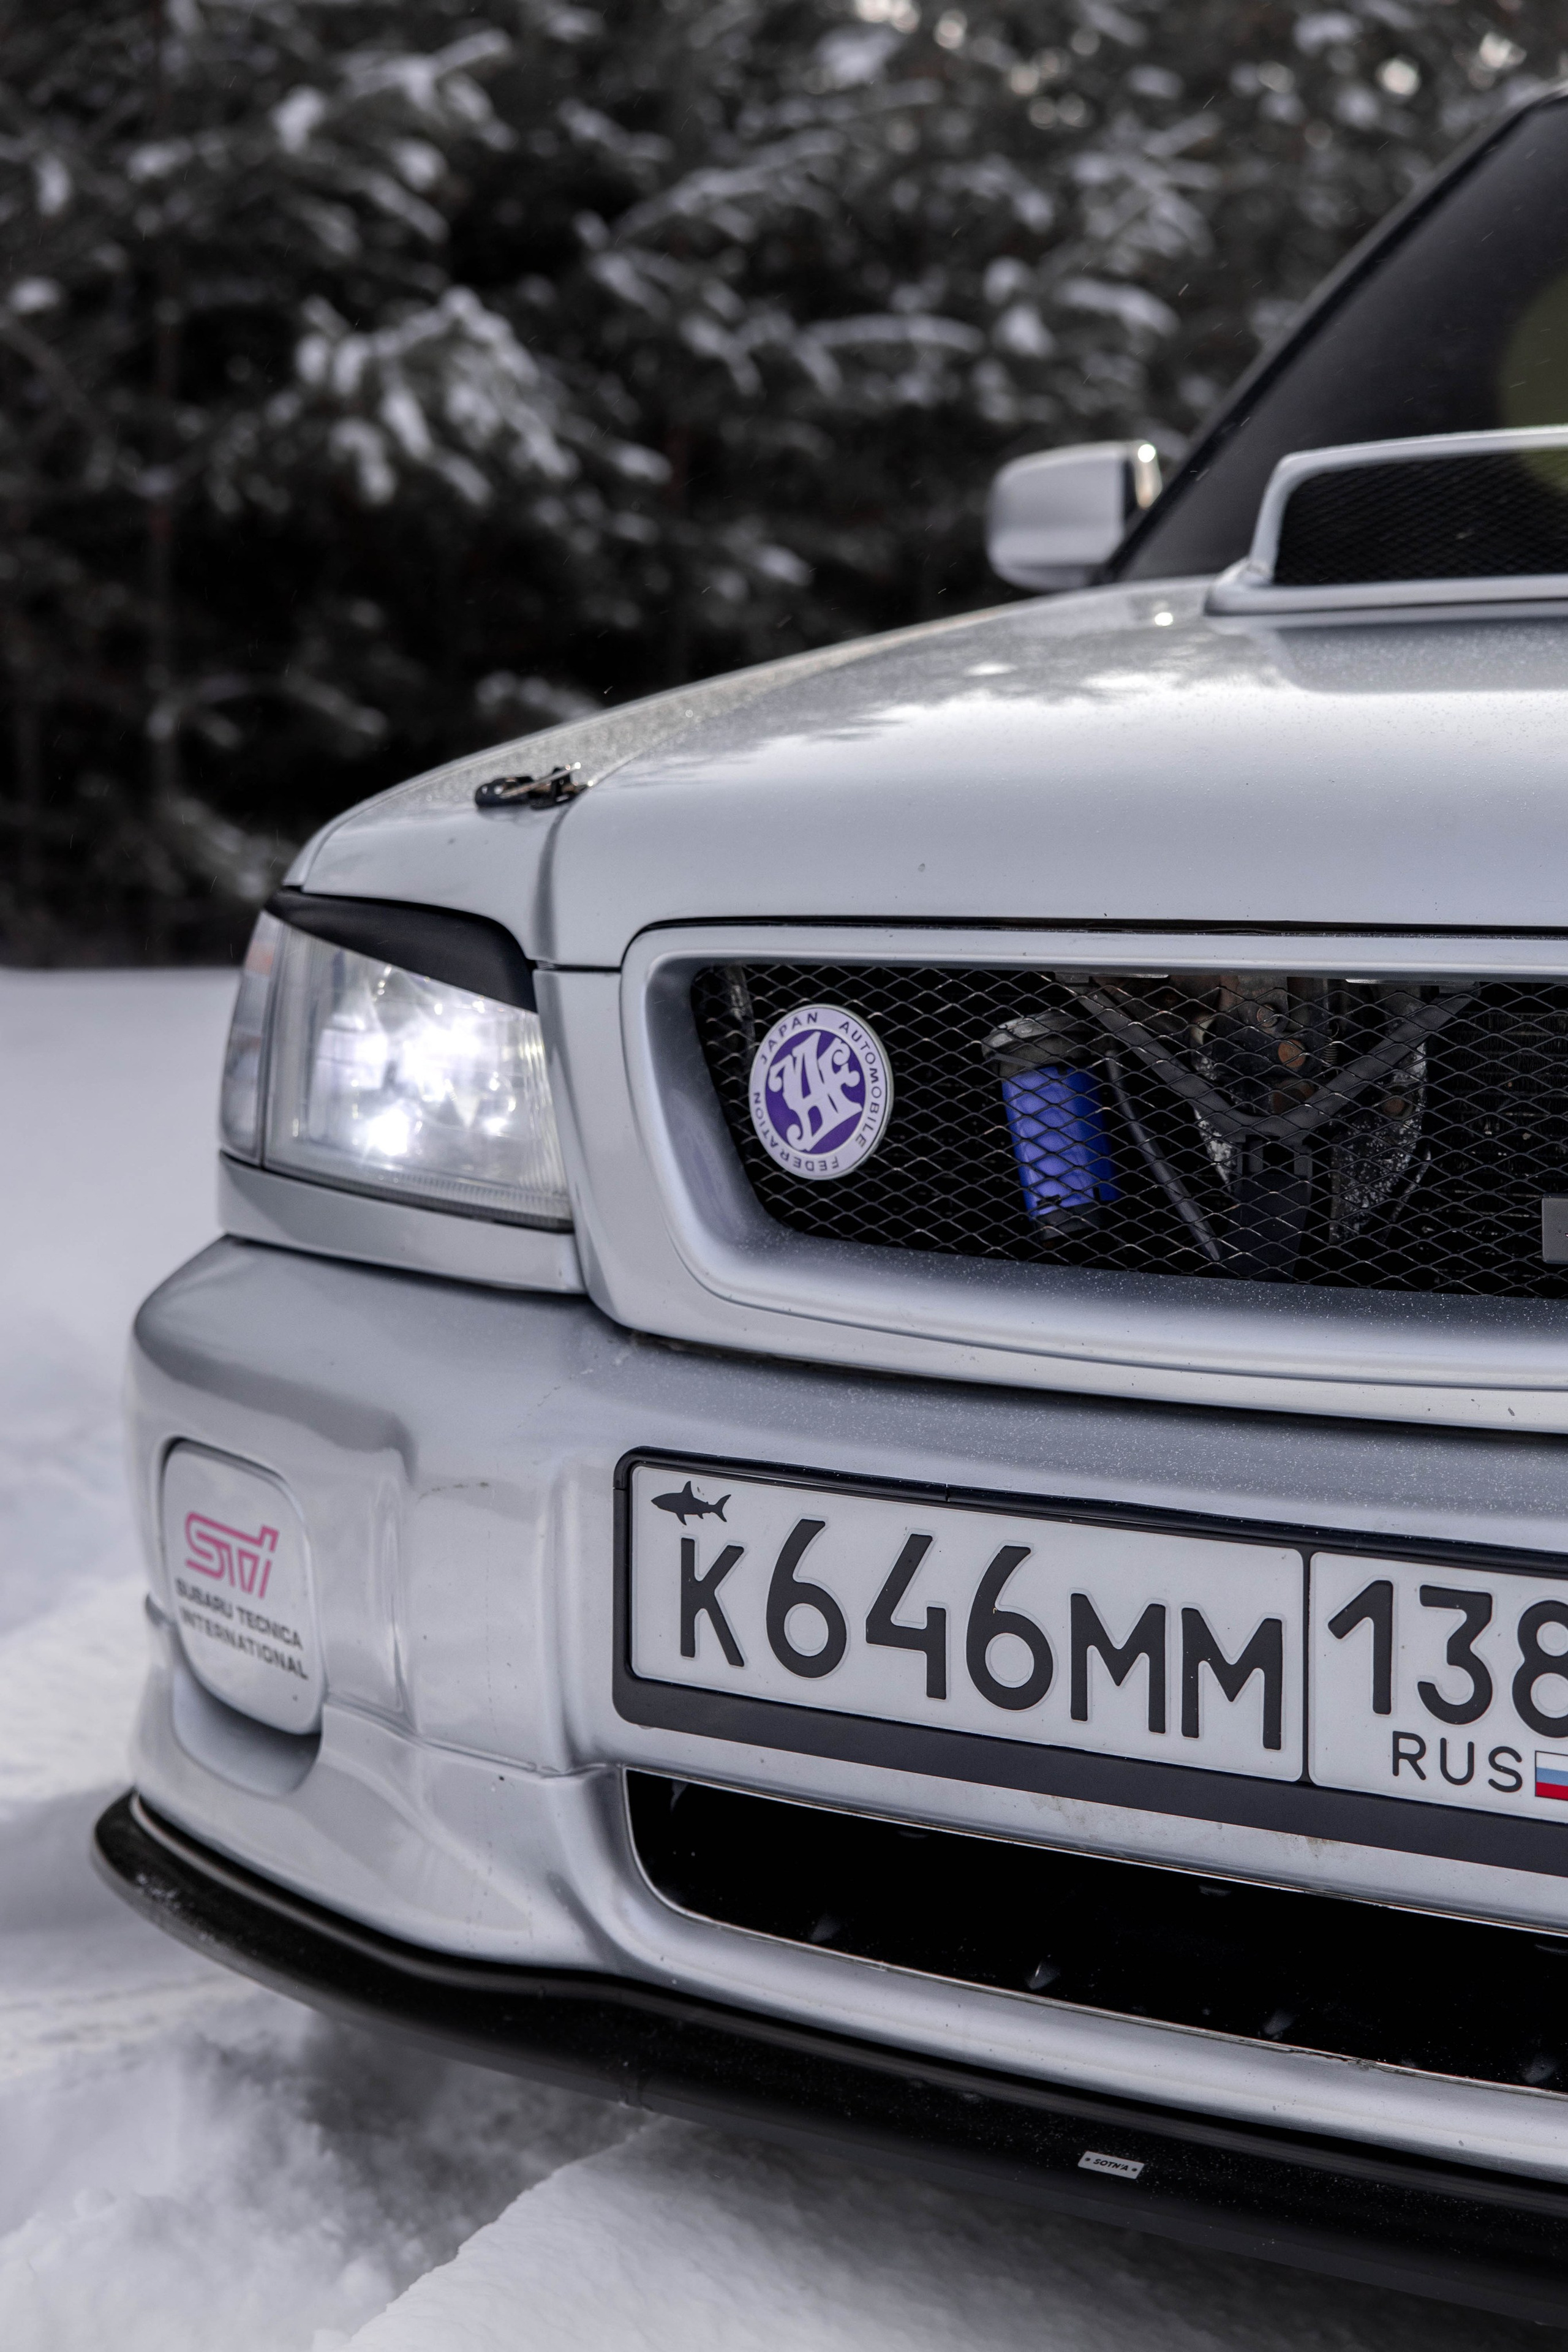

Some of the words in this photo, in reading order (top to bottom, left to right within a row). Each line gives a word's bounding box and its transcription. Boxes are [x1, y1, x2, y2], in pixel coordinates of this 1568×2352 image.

[761, 1012, 818, 1065] JAPAN
[839, 1021, 881, 1147] AUTOMOBILE
[754, 1092, 839, 1172] FEDERATION
[175, 1577, 234, 1621] SUBARU
[236, 1605, 303, 1649] TECNICA
[179, 1606, 309, 1680] INTERNATIONAL
[1328, 1580, 1568, 1738] 138
[1392, 1730, 1523, 1793] RUS
